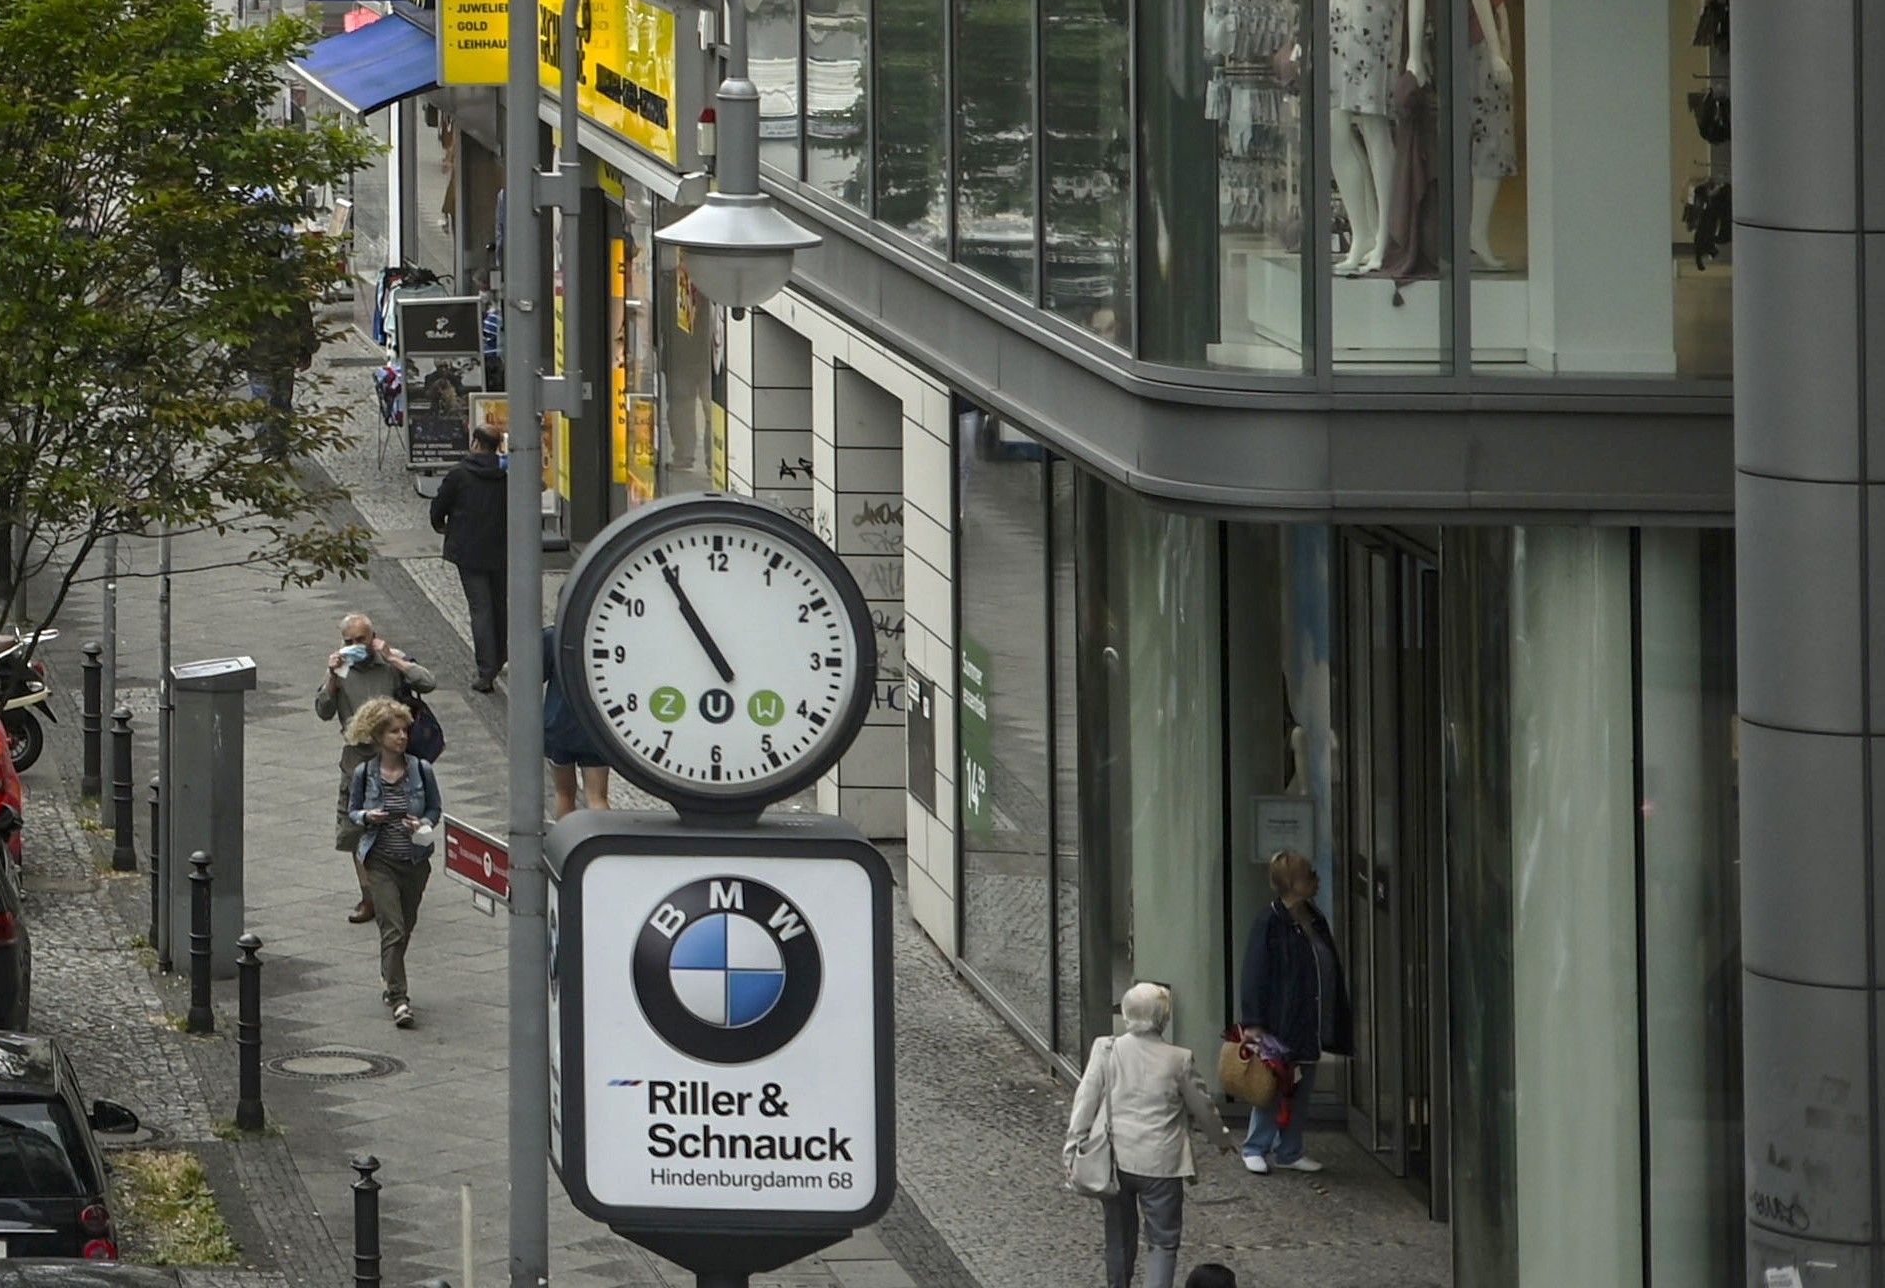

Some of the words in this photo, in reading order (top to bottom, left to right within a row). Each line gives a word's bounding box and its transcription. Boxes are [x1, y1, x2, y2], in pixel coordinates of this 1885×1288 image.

[457, 21, 488, 32] GOLD
[457, 39, 507, 50] LEIHHAU
[707, 553, 728, 572] 12
[763, 569, 772, 587] 1
[625, 598, 645, 617] 10
[798, 605, 809, 623] 2
[614, 645, 626, 664] 9
[810, 653, 821, 672] 3
[626, 693, 638, 712] 8
[796, 699, 808, 719] 4
[662, 730, 674, 749] 7
[761, 734, 772, 753] 5
[711, 744, 722, 763] 6
[649, 880, 807, 942] BMW
[647, 1079, 753, 1117] Riller
[758, 1082, 790, 1118] &
[647, 1122, 854, 1163] Schnauck
[651, 1167, 823, 1192] Hindenburgdamm
[828, 1172, 854, 1190] 68
